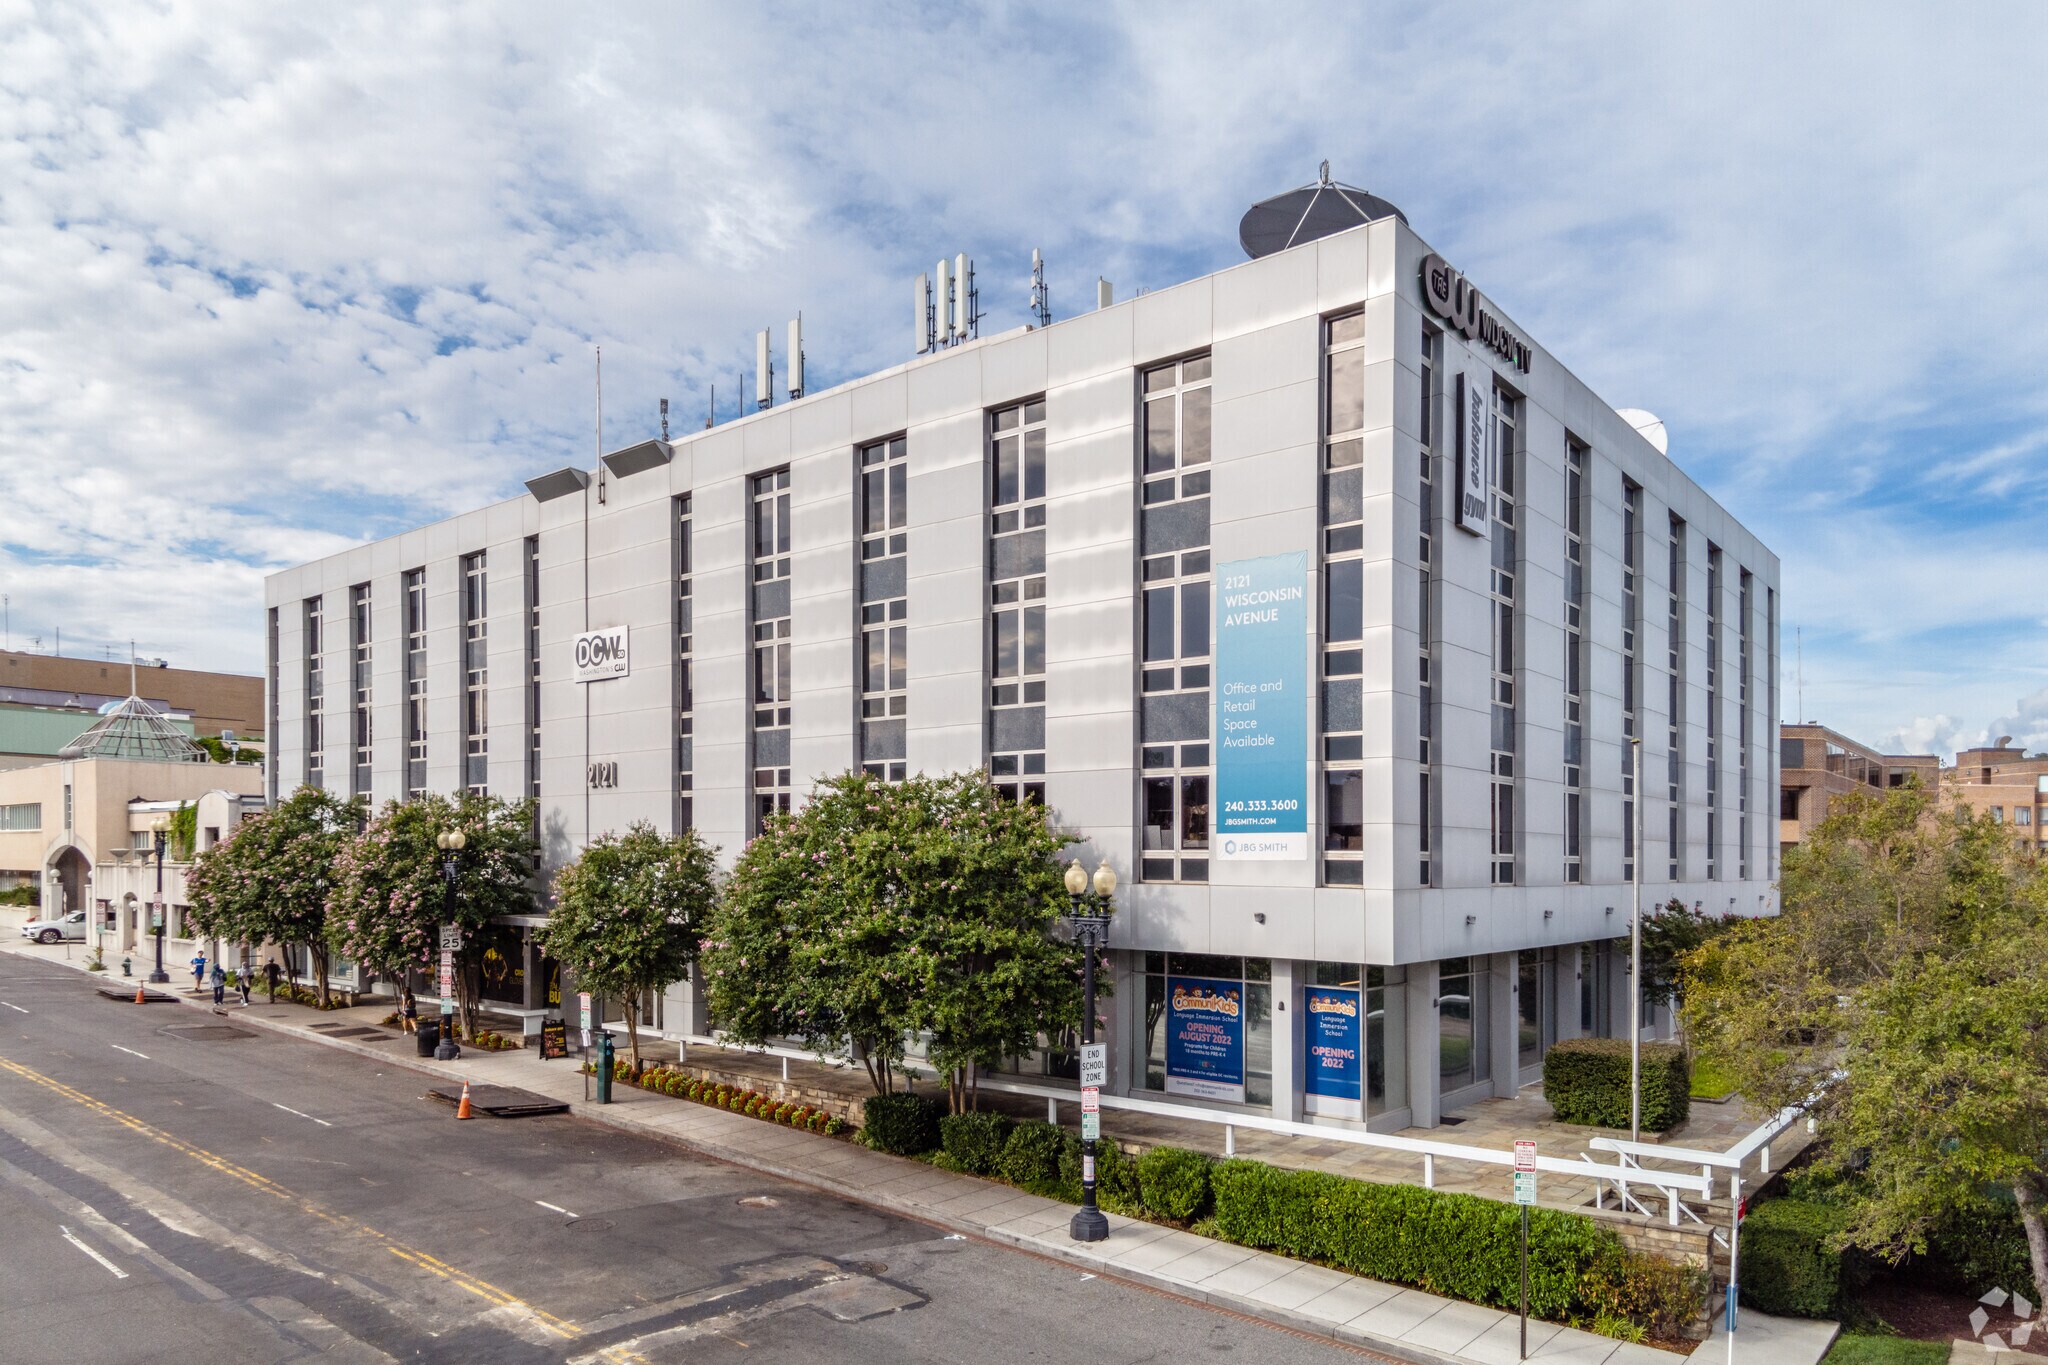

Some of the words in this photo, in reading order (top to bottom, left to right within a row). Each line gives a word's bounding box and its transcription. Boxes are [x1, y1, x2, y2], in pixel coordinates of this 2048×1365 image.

[1433, 271, 1447, 299] THE
[1472, 386, 1482, 490] balance
[1464, 492, 1486, 522] gym
[1225, 574, 1250, 589] 2121
[1225, 586, 1302, 608] WISCONSIN
[1225, 608, 1278, 627] AVENUE
[576, 635, 620, 668] DCW
[1224, 682, 1256, 695] Office
[1260, 678, 1282, 692] and
[1224, 699, 1256, 712] Retail
[1224, 718, 1258, 733] Space
[1224, 734, 1275, 748] Available
[588, 762, 618, 788] 2121
[1225, 800, 1298, 812] 240.333.3600
[1240, 844, 1256, 852] JBG
[1258, 843, 1288, 852] SMITH
[442, 939, 459, 948] 25
[1320, 1022, 1348, 1030] Immersion
[1322, 1015, 1346, 1024] Language
[1186, 1022, 1224, 1034] OPENING
[1179, 1032, 1211, 1042] AUGUST
[1212, 1035, 1232, 1045] 2022
[1088, 1050, 1100, 1058] END
[1312, 1046, 1354, 1060] OPENING
[1082, 1060, 1104, 1070] SCHOOL
[1322, 1058, 1344, 1068] 2022
[1086, 1072, 1101, 1082] ZONE
